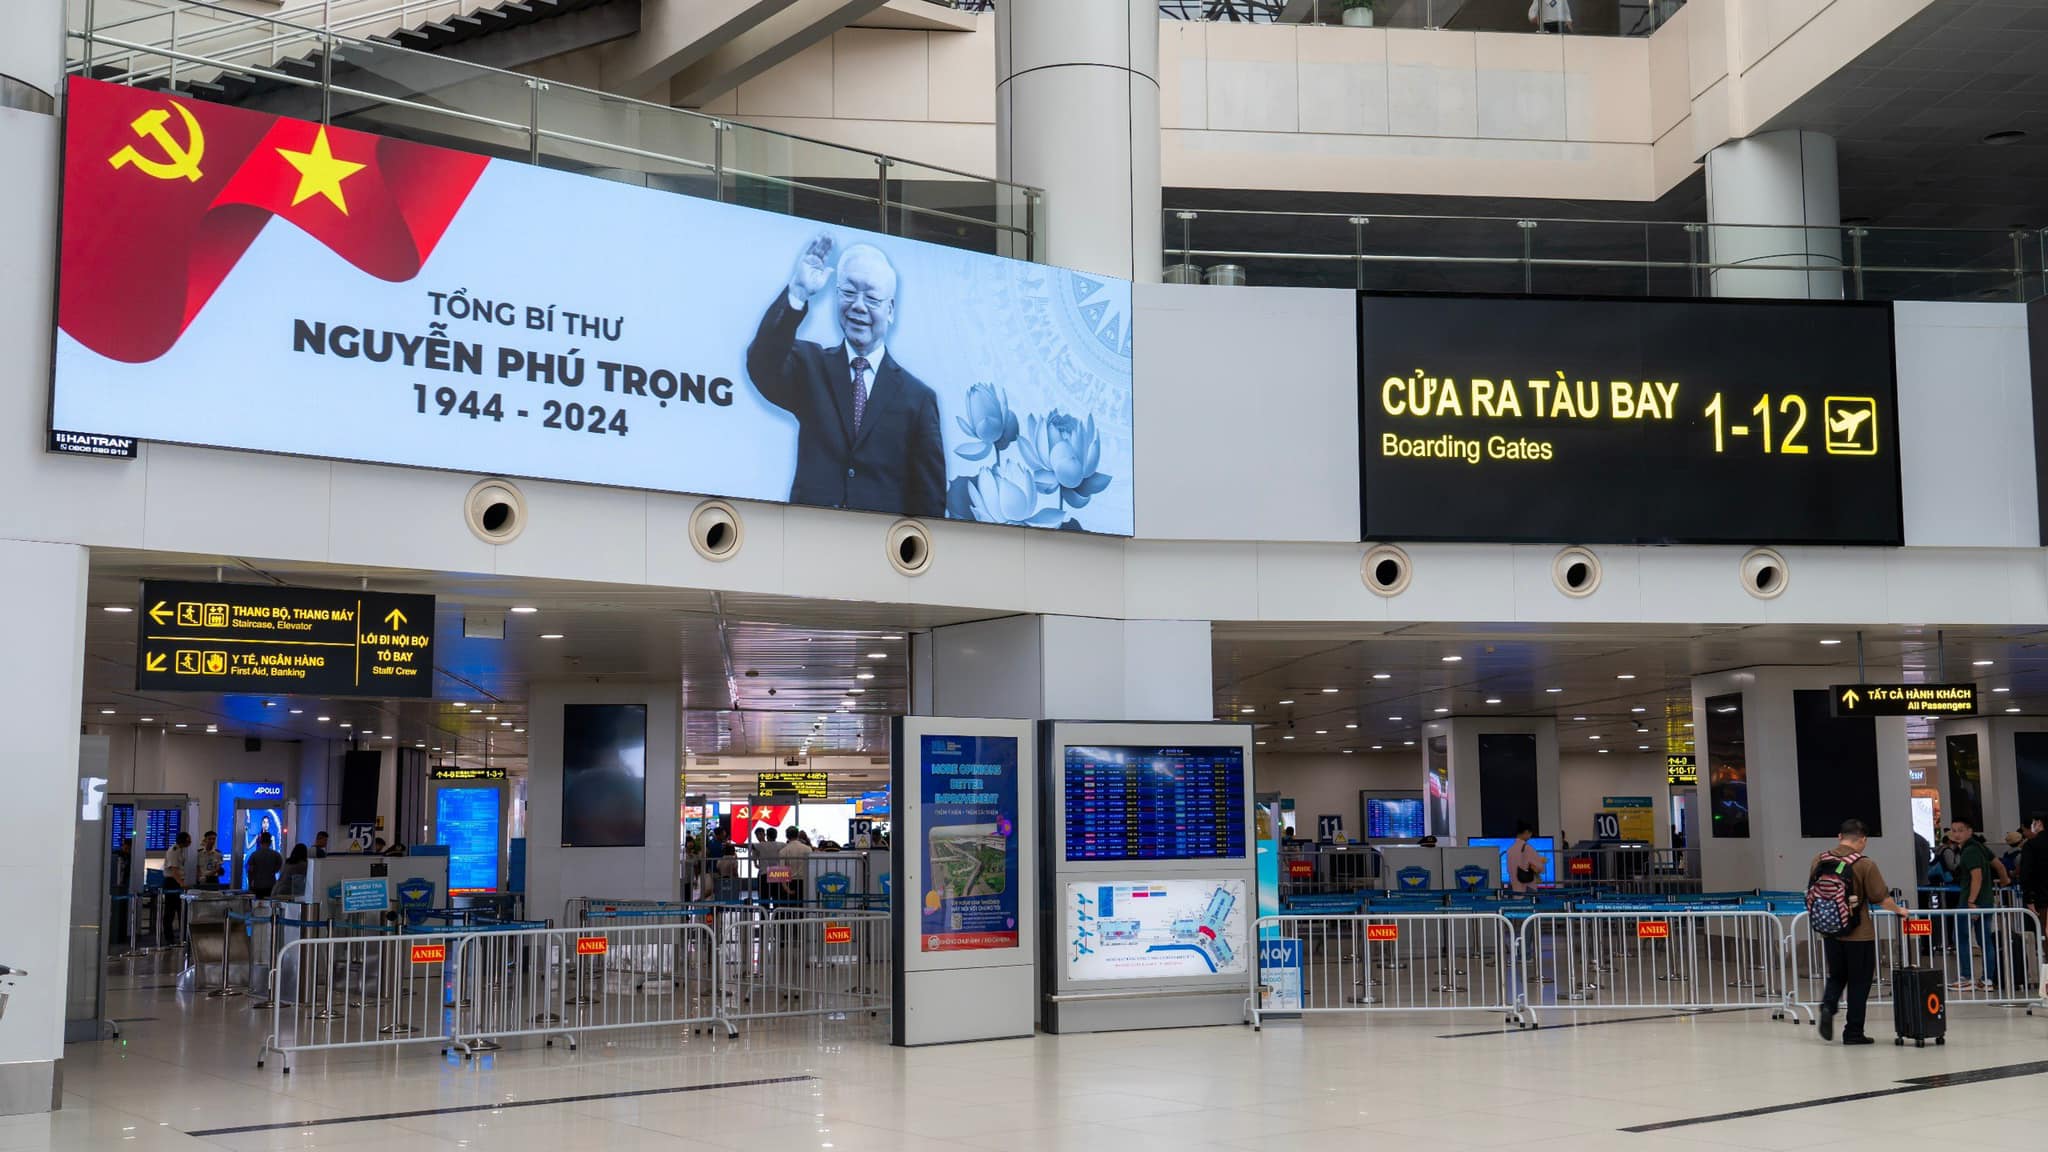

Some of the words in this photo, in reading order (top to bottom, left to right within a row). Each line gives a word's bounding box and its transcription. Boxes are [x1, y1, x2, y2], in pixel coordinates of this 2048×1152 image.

[427, 287, 516, 326] TỔNG
[526, 305, 556, 332] BÍ
[562, 311, 624, 342] THƯ
[293, 319, 483, 375] NGUYỄN
[498, 347, 584, 387] PHÚ
[597, 361, 733, 408] TRỌNG
[1382, 369, 1462, 417] CỬA
[1471, 379, 1522, 418] RA
[1528, 370, 1600, 420] TÀU
[1611, 382, 1679, 420] BAY
[414, 383, 504, 422] 1944
[543, 400, 629, 436] 2024
[1704, 392, 1809, 454] 1-12
[1382, 433, 1481, 464] Boarding
[1487, 435, 1553, 461] Gates
[233, 606, 270, 618] THANG
[272, 606, 291, 621] BỘ,
[293, 609, 330, 620] THANG
[331, 608, 354, 621] MÁY
[277, 621, 312, 631] Elevator
[379, 635, 390, 646] ĐI
[232, 654, 240, 665] Y
[261, 653, 294, 666] NGÂN
[296, 653, 324, 667] HÀNG
[393, 651, 413, 662] BAY
[231, 667, 250, 675] First
[271, 668, 305, 678] Banking
[395, 667, 417, 675] Crew
[1867, 687, 1887, 699] TẤT
[1889, 687, 1904, 699] CẢ
[1906, 688, 1934, 699] HÀNH
[1936, 688, 1971, 699] KHÁCH
[1908, 702, 1919, 710] All
[1921, 701, 1972, 712] Passengers
[1598, 816, 1618, 837] 10
[350, 826, 373, 849] 15
[1369, 928, 1396, 937] ANHK
[1640, 925, 1666, 934] ANHK
[827, 931, 849, 940] ANHK
[579, 941, 605, 951] ANHK
[413, 949, 442, 959] ANHK
